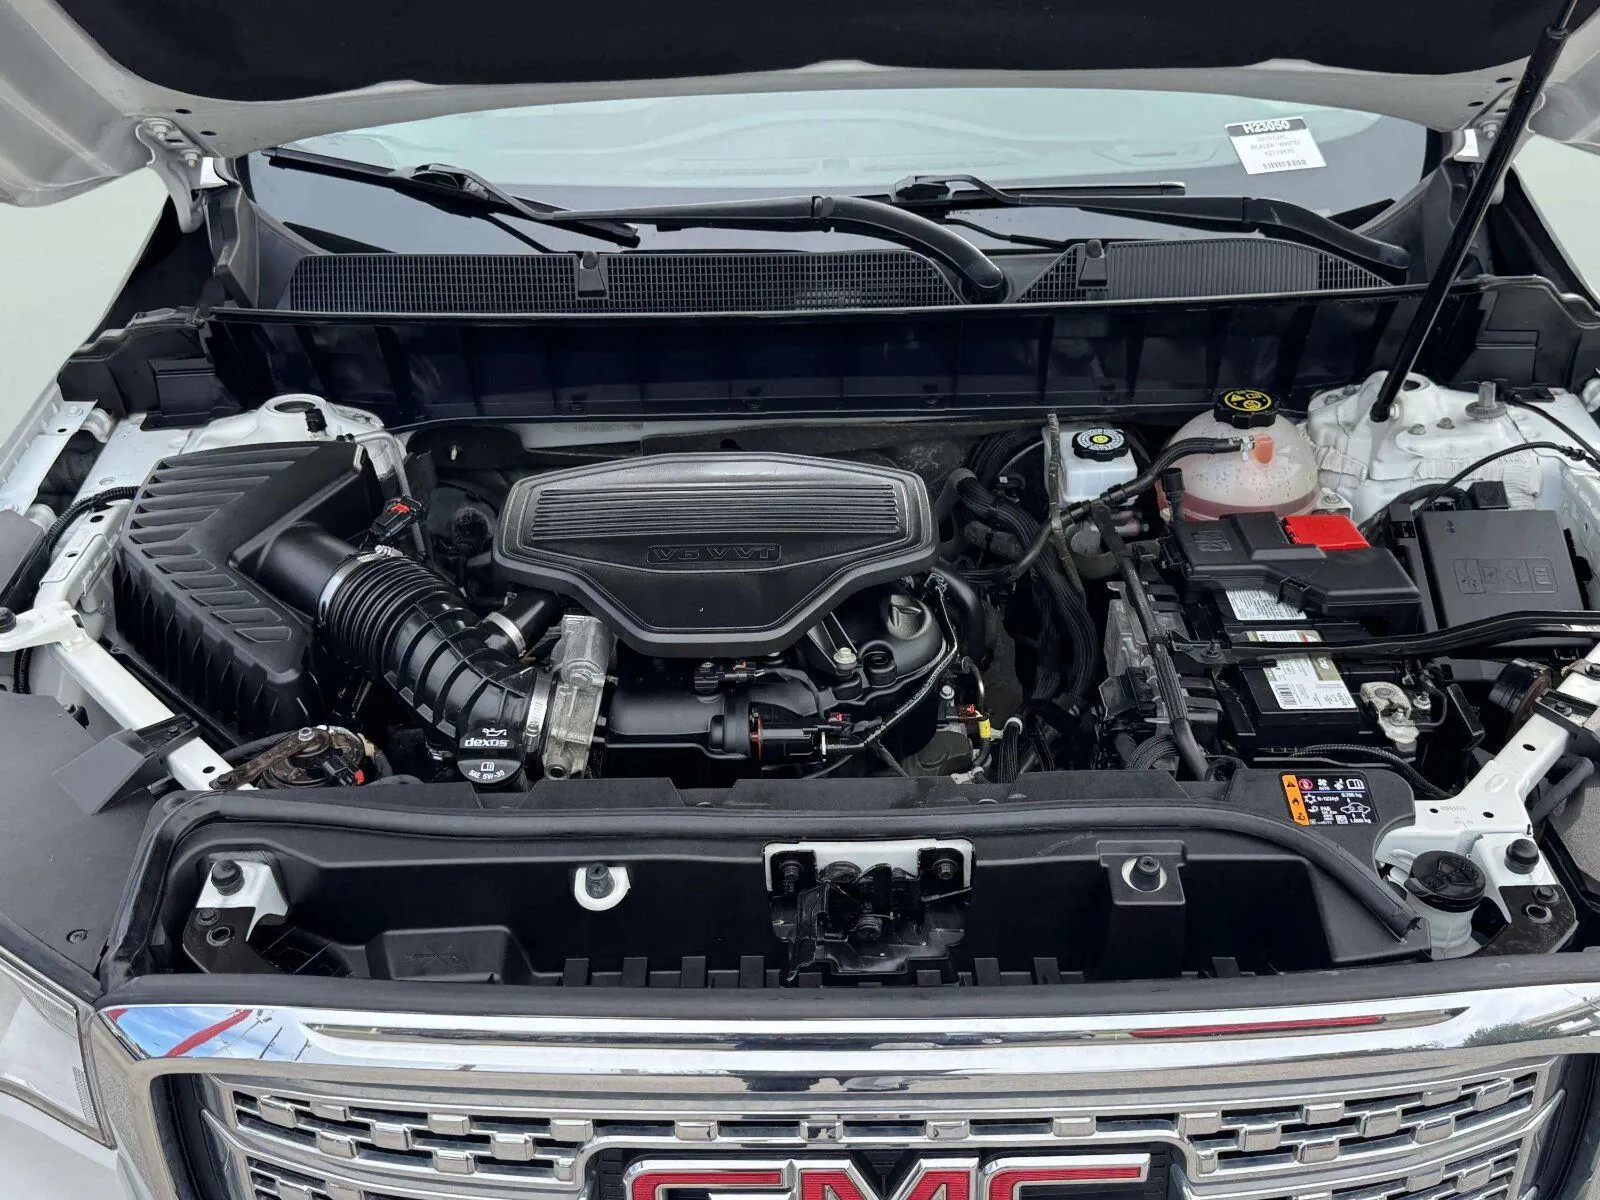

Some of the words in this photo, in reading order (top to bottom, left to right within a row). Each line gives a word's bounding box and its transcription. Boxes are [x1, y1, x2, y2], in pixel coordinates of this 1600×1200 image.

[1243, 120, 1291, 134] H23050
[707, 547, 776, 559] VVT
[465, 738, 508, 747] dexos
[469, 770, 481, 779] SAE
